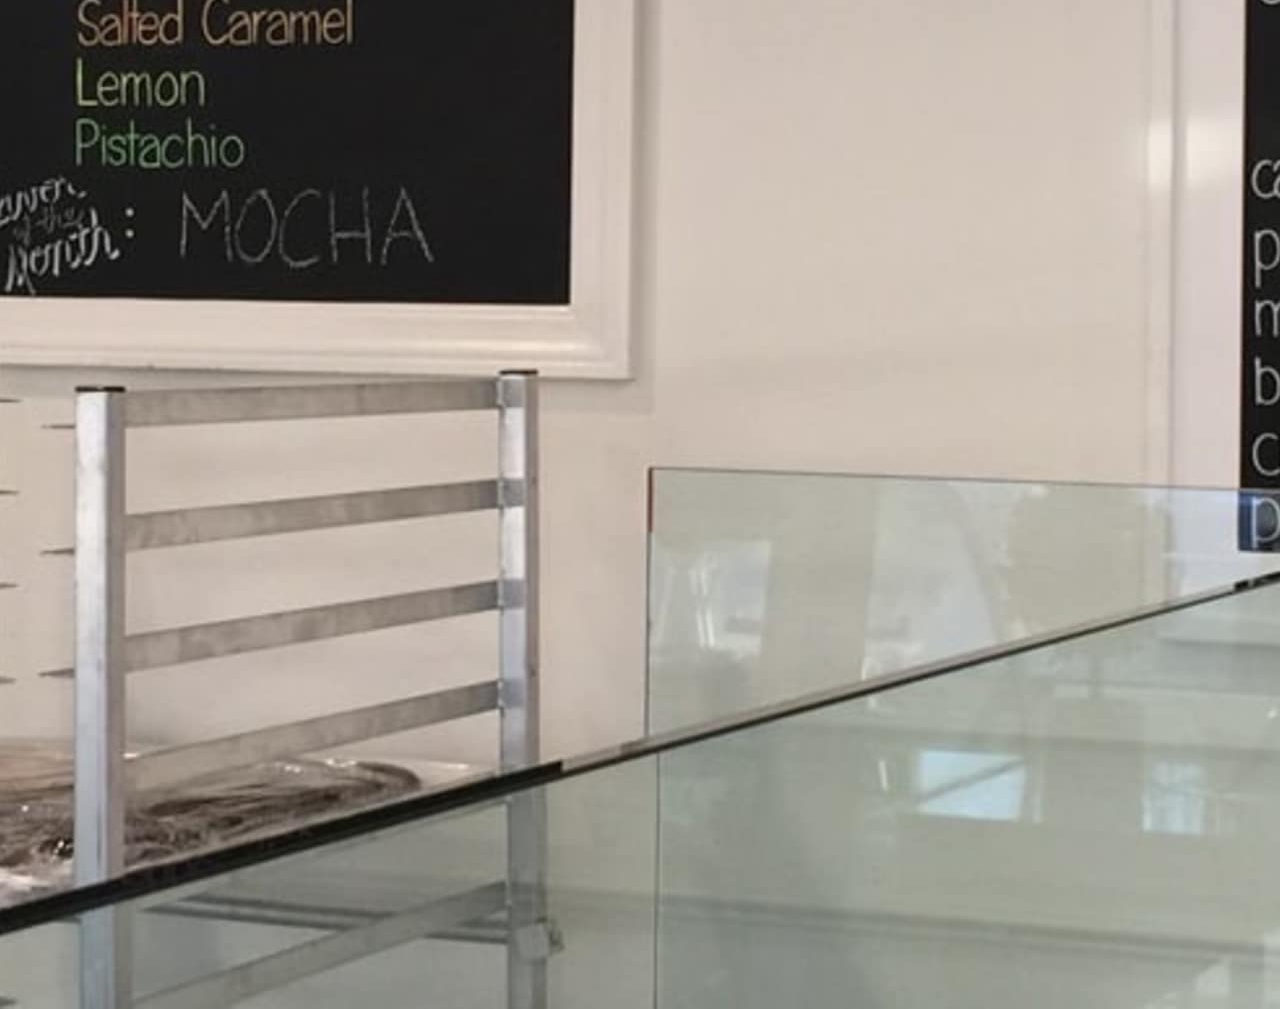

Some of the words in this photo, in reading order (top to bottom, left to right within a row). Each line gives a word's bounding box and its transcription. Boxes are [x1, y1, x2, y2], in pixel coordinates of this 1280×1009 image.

[77, 57, 205, 107] Lemon
[76, 118, 245, 169] Pistachio
[180, 188, 434, 268] MOCHA
